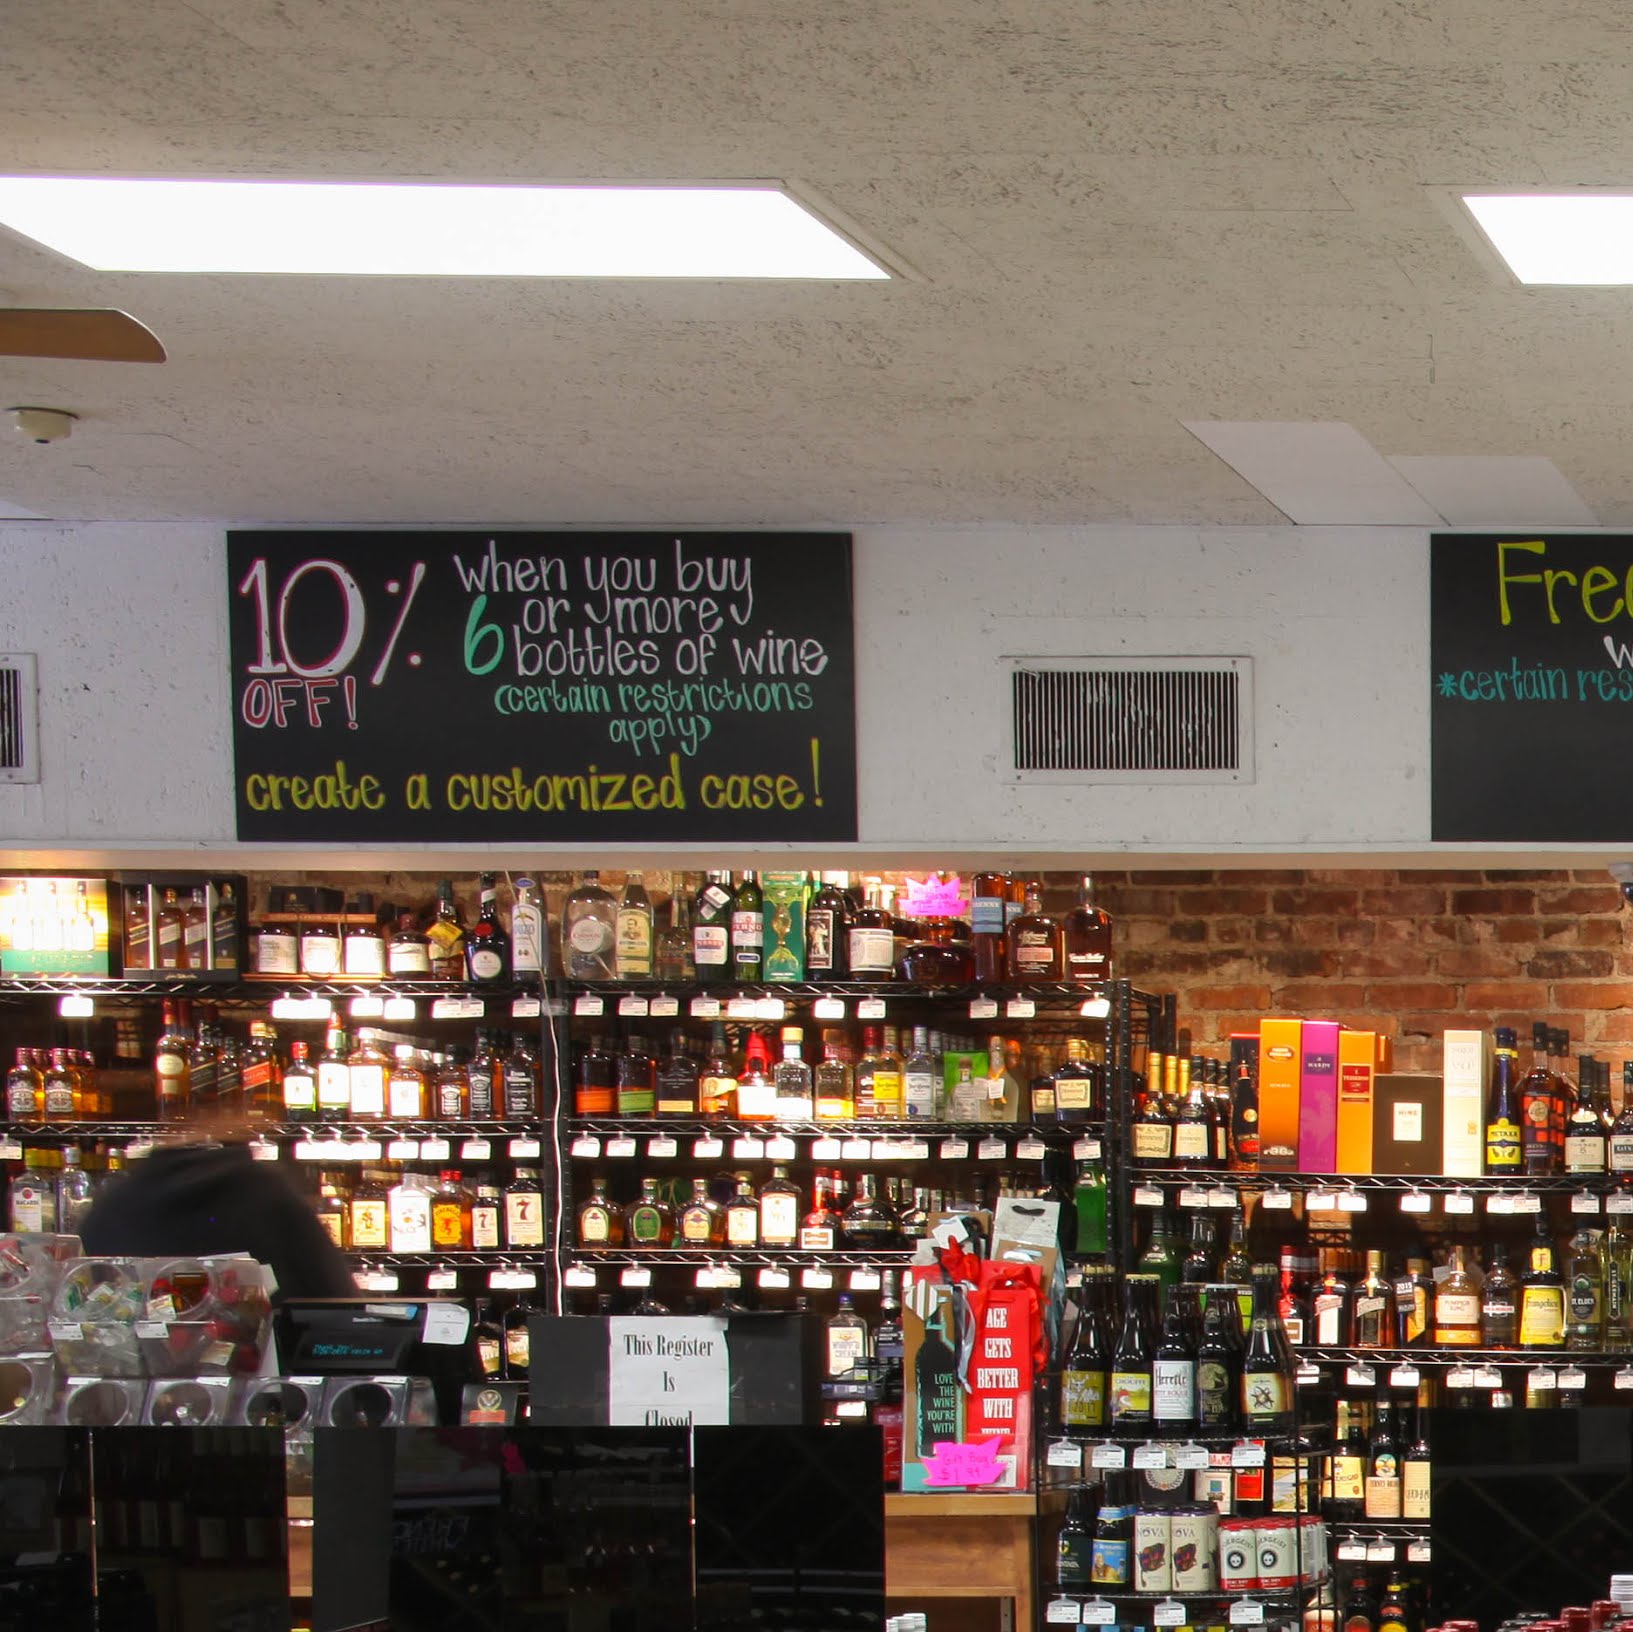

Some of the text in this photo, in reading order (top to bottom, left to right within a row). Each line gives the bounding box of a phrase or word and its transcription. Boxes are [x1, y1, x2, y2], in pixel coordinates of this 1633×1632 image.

[453, 540, 753, 626] when you buy
[238, 556, 428, 687] 10%
[464, 595, 724, 676] 6 or more
[513, 625, 829, 677] bottles of wine
[241, 677, 359, 731] OFF!
[494, 679, 813, 715] (certain restrictions
[609, 713, 712, 757] apply)
[246, 739, 824, 811] create a customized case!
[516, 1199, 531, 1220] 7
[479, 1213, 487, 1228] 7
[986, 1308, 1007, 1328] AGE
[624, 1334, 714, 1360] This Register
[985, 1338, 1012, 1358] GETS
[663, 1370, 675, 1392] Is
[934, 1373, 954, 1385] LOVE
[977, 1368, 1019, 1388] BETTER
[940, 1386, 954, 1397] THE
[933, 1398, 955, 1408] WINE
[983, 1398, 1013, 1418] WITH
[927, 1410, 955, 1421] YOU'RE
[933, 1422, 955, 1433] WITH
